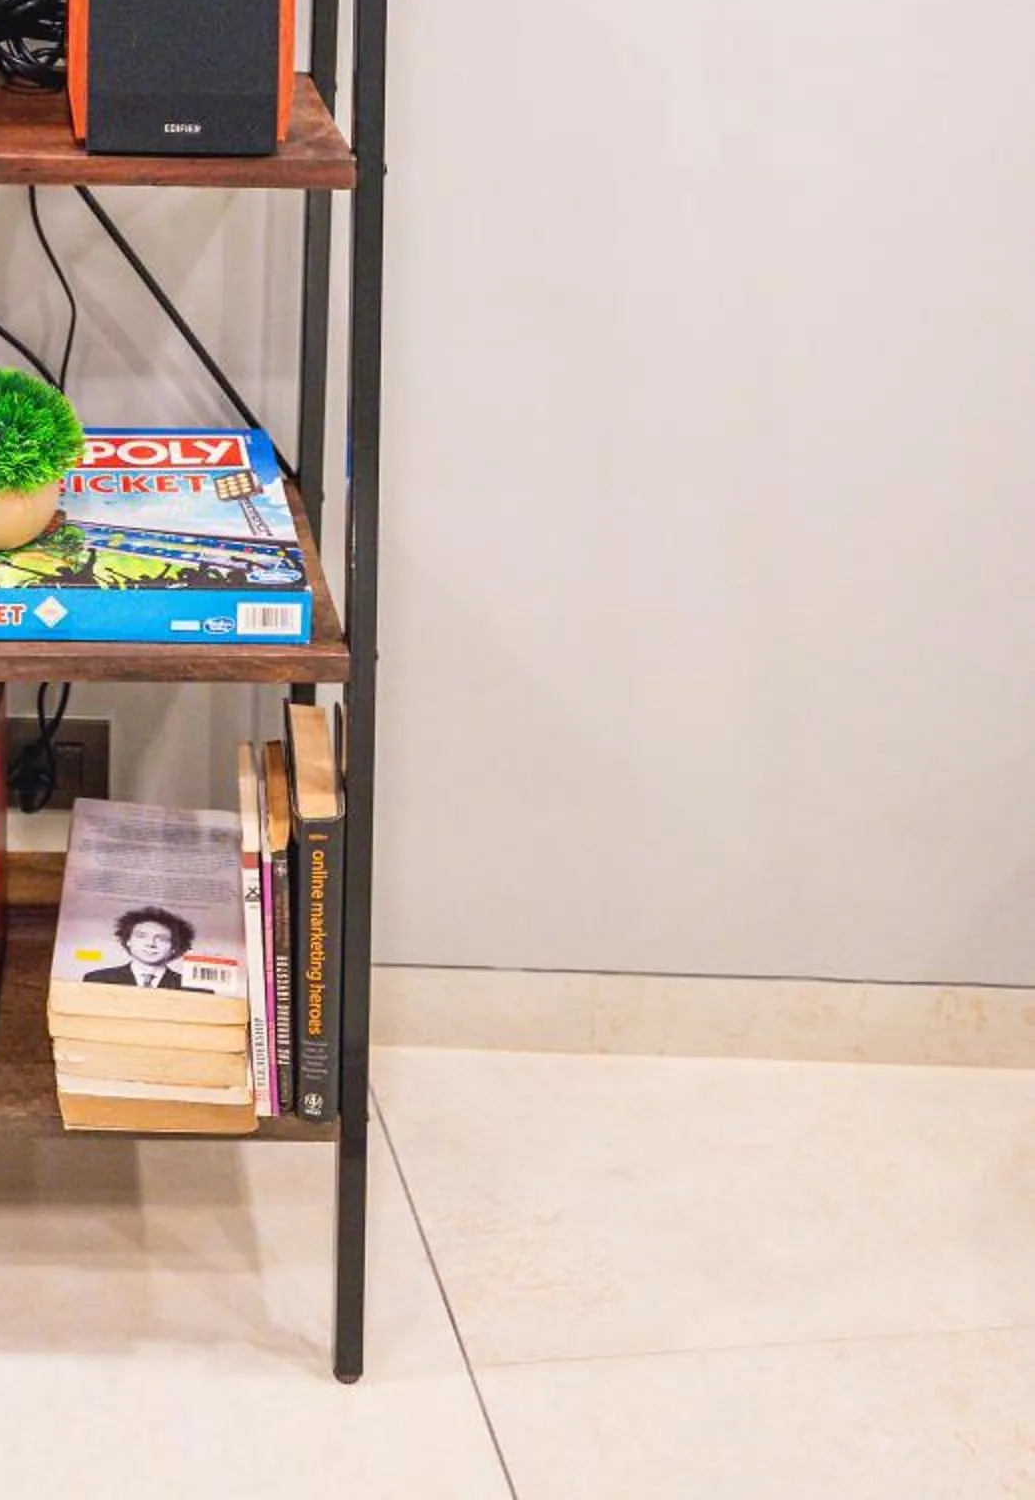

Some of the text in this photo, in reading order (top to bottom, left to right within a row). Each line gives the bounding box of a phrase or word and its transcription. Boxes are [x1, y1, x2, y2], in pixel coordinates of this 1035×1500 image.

[311, 849, 328, 900] online
[306, 903, 327, 982] marketing
[308, 983, 325, 1037] heroes
